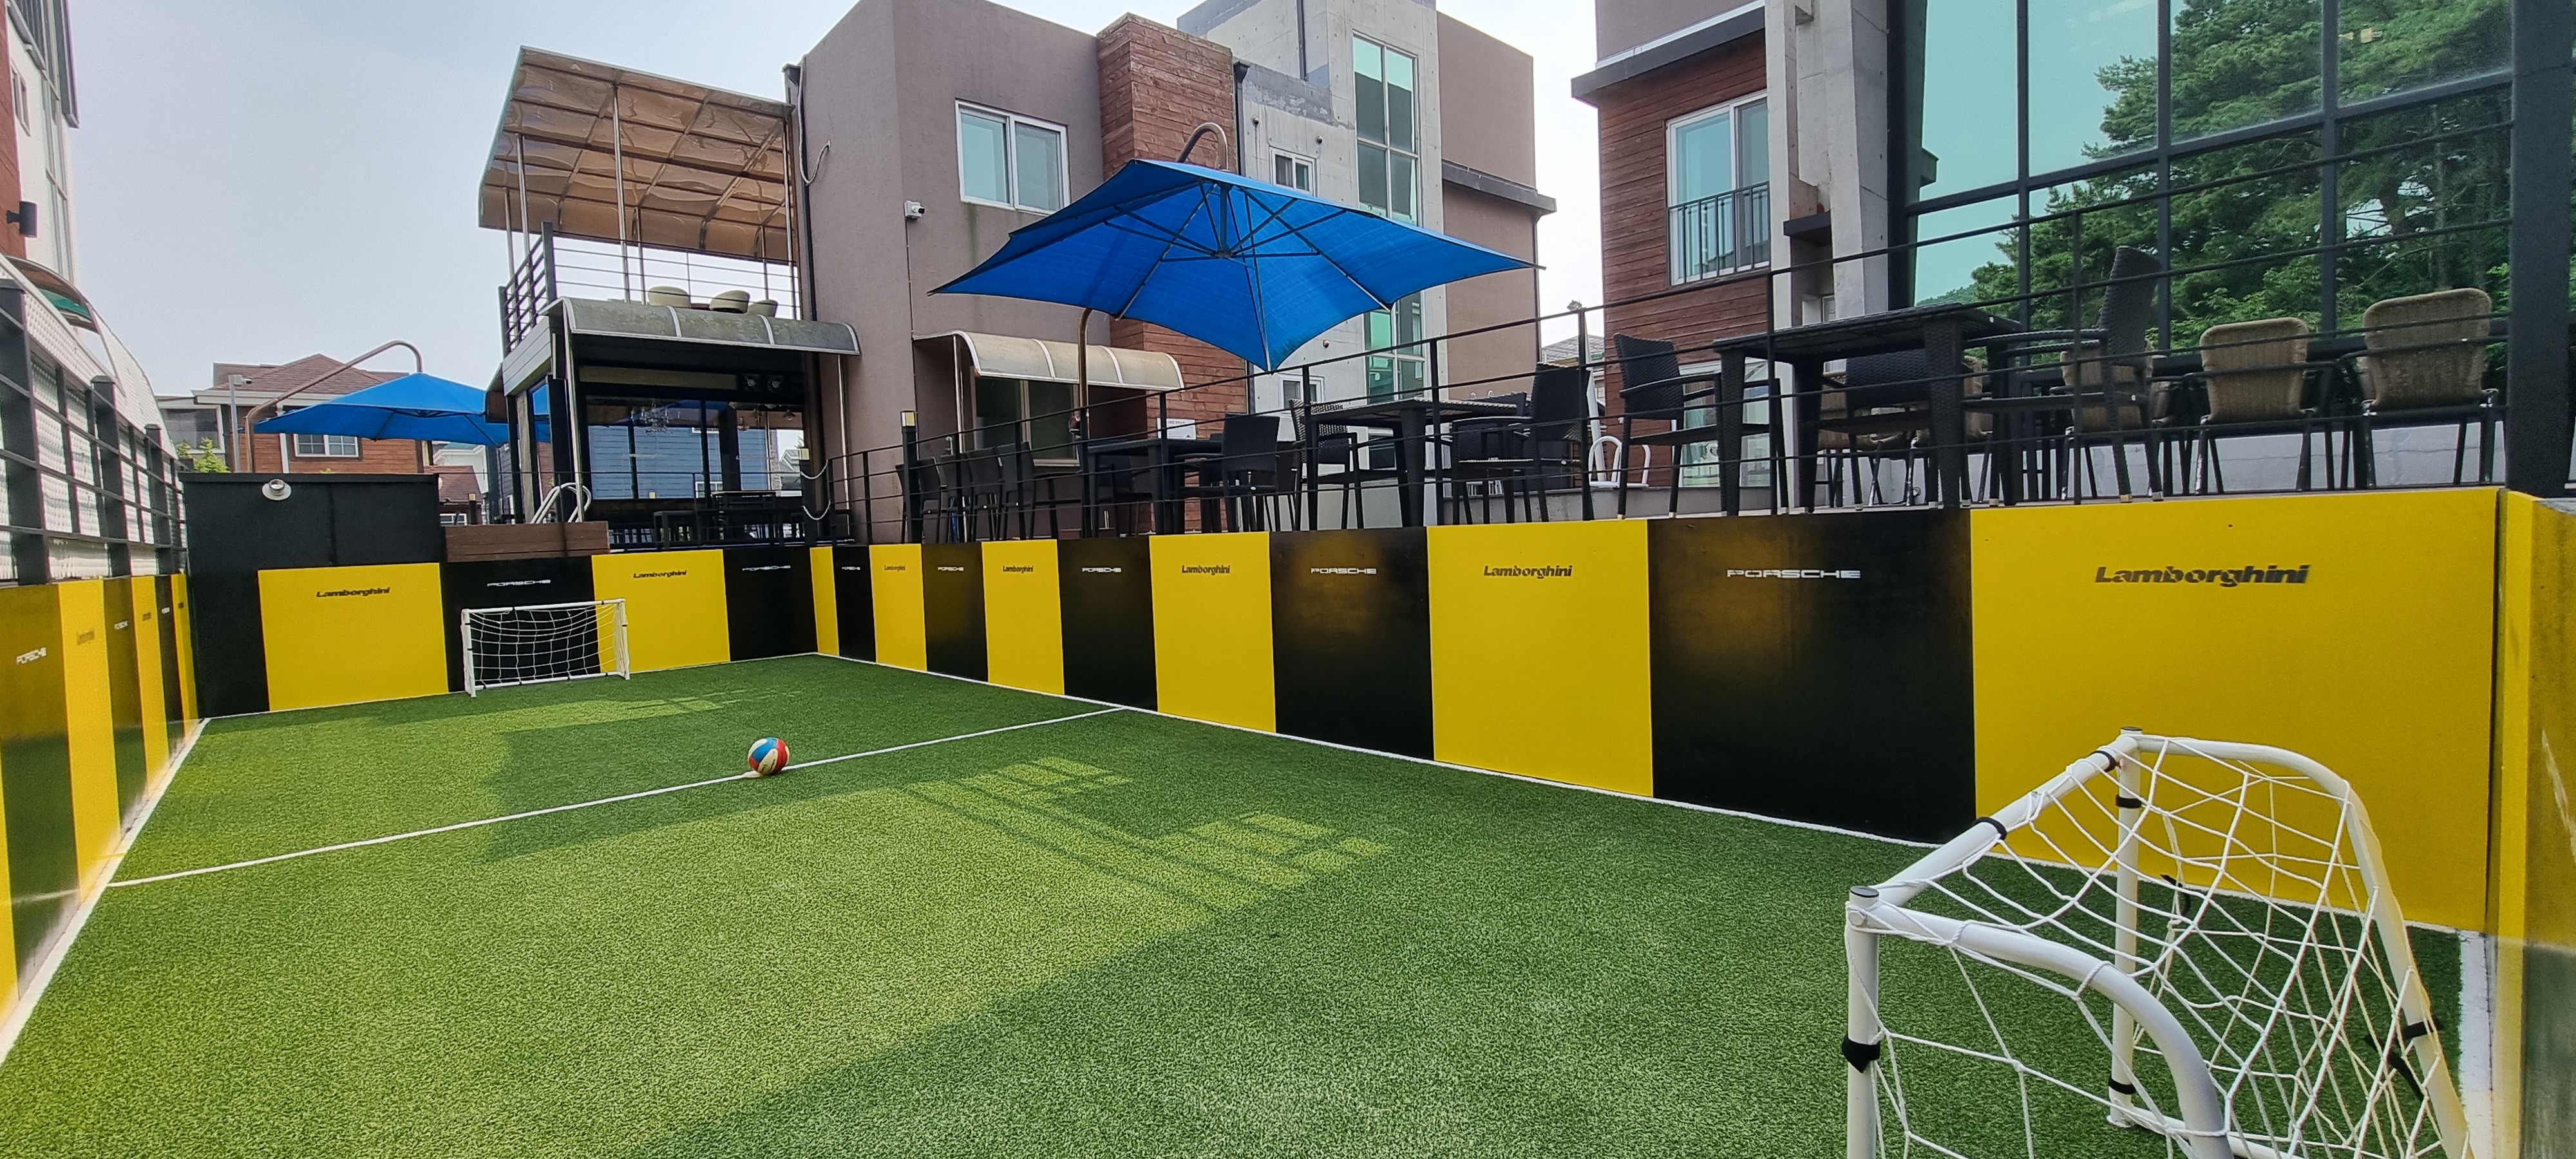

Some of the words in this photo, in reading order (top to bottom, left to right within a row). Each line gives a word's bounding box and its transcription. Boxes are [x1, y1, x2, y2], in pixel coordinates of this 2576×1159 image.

[633, 569, 687, 579] Lamborghini
[1002, 565, 1034, 574] Lamborghini
[1181, 564, 1231, 576] Lamborghini
[1483, 564, 1574, 580] Lamborghini
[1727, 569, 1861, 579] PORSCHE
[2094, 564, 2311, 589] Lamborghini
[486, 578, 552, 587] PORSCHE
[316, 586, 390, 599] Lamborghini
